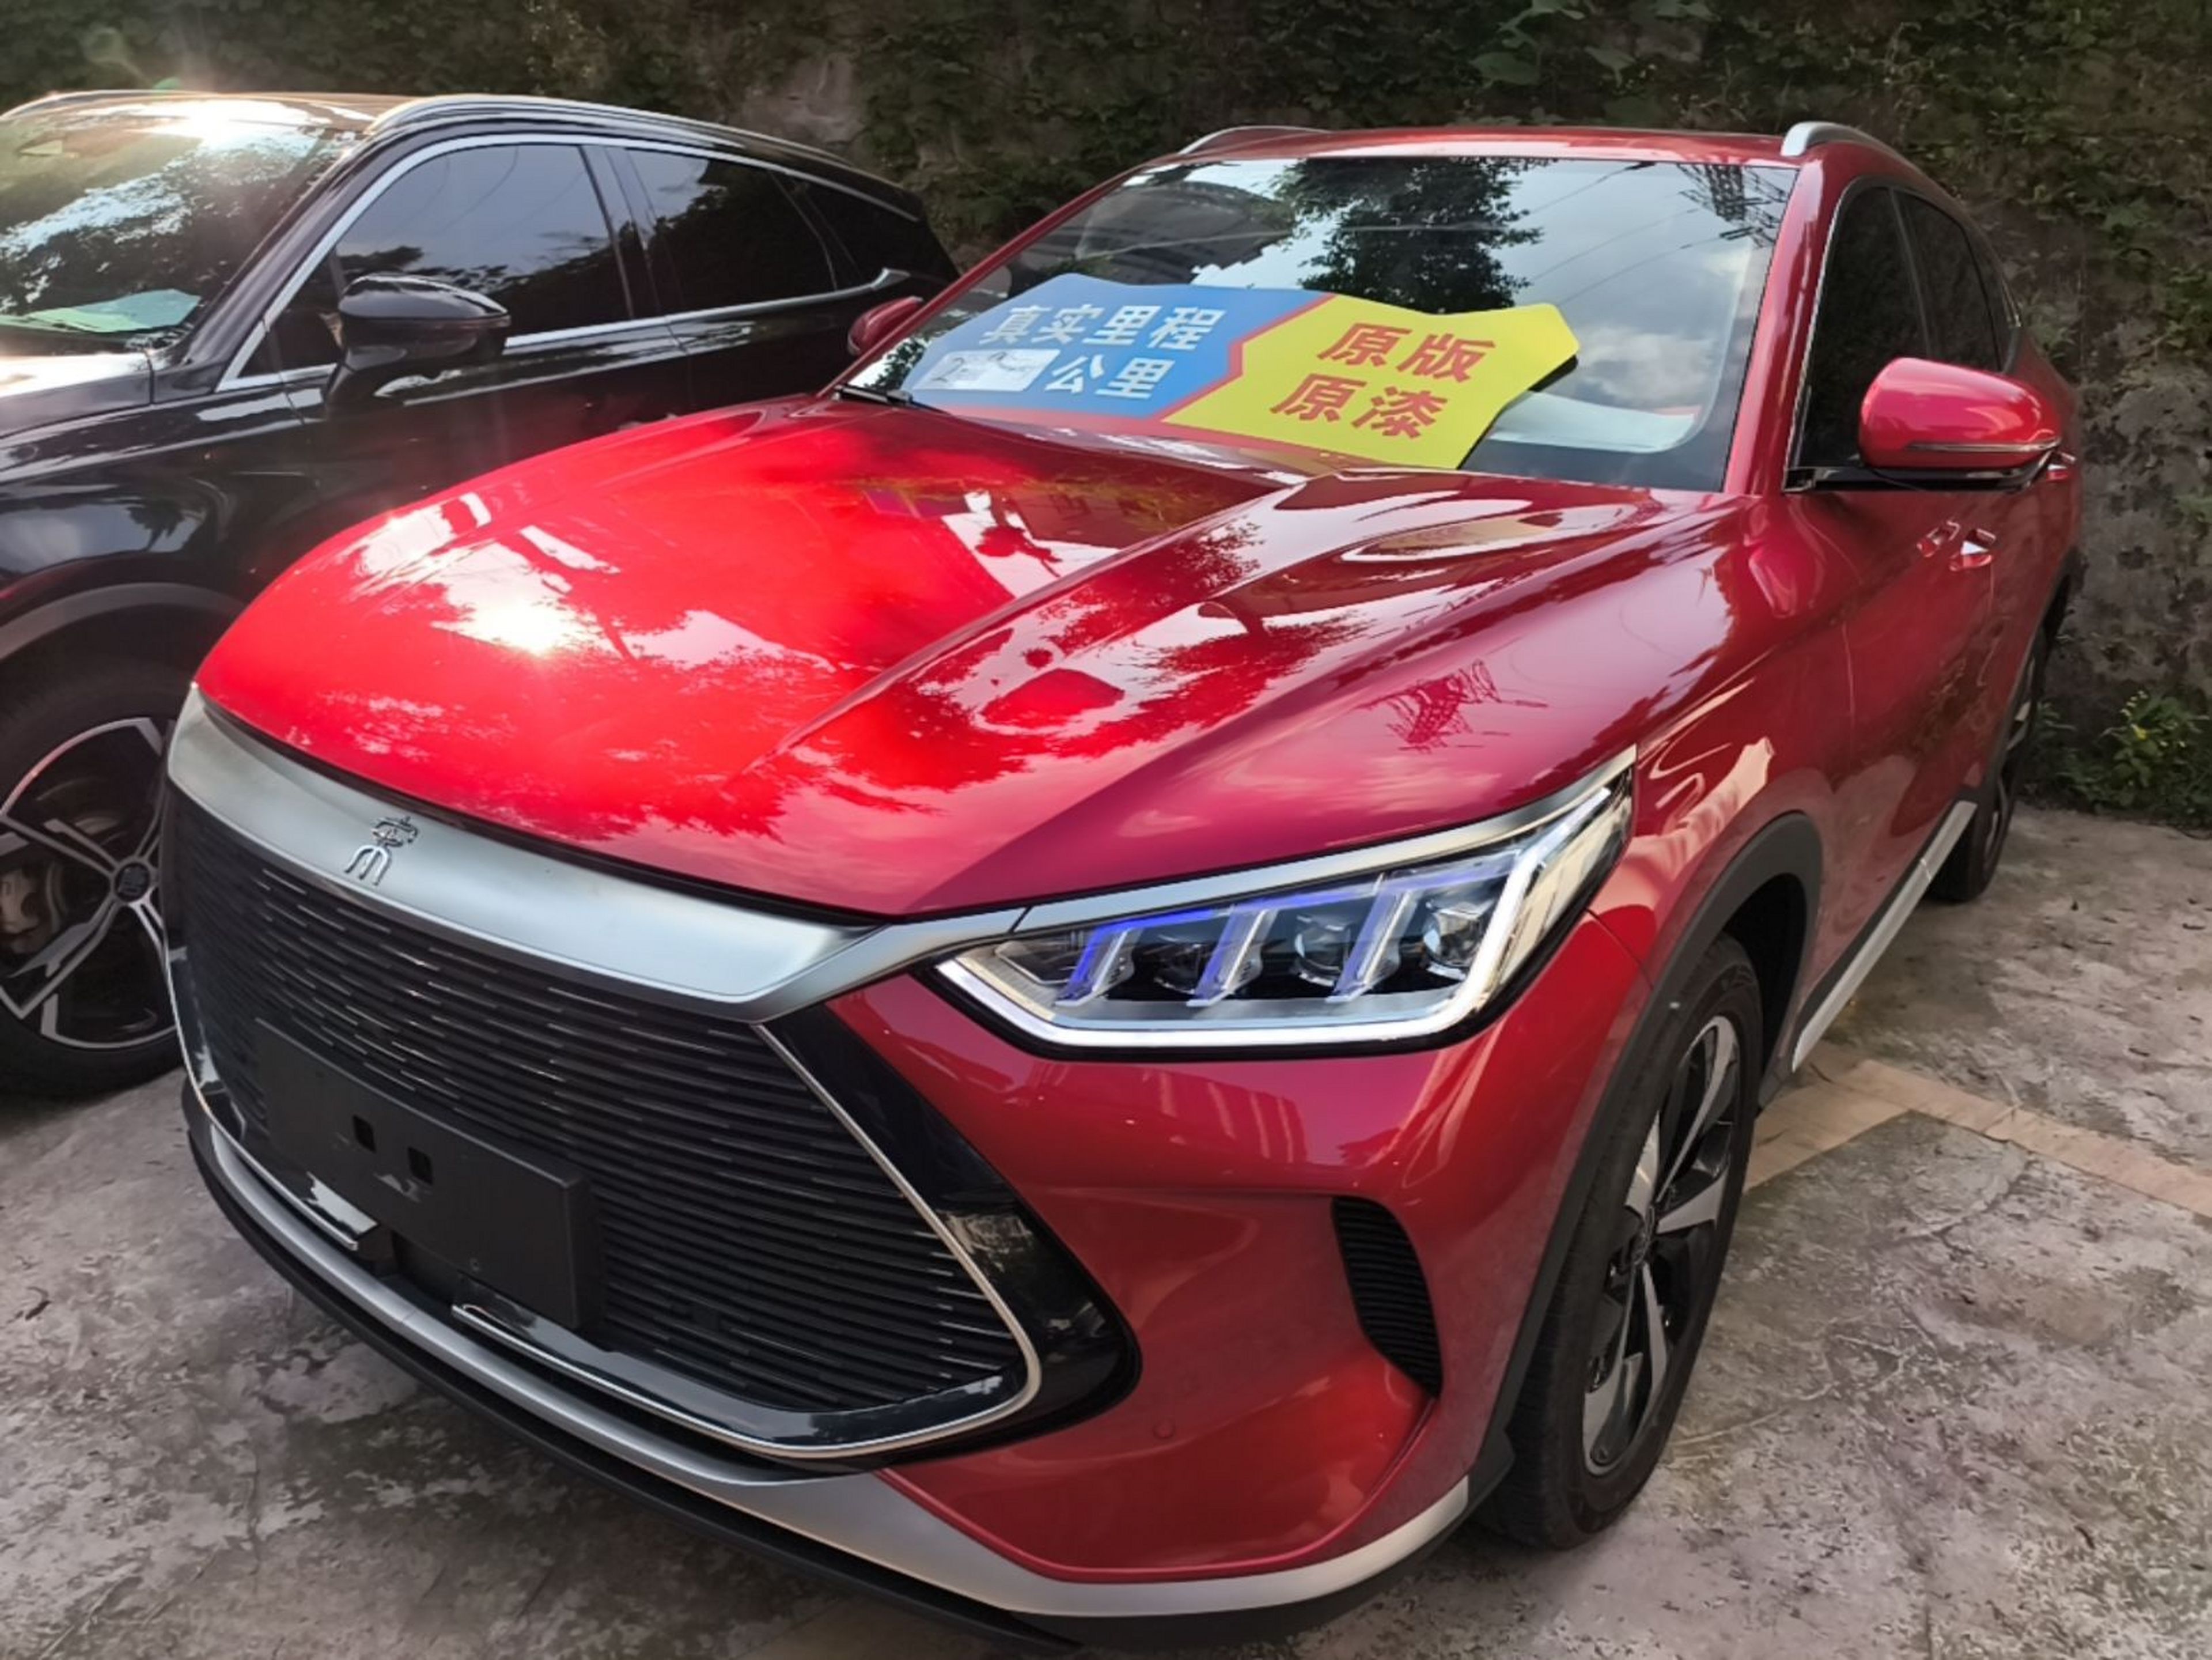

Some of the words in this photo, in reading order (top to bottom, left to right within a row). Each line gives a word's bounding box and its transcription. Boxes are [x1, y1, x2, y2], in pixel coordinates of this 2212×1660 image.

[979, 305, 1226, 351] 真实里程
[1317, 322, 1496, 383] 原版
[1044, 354, 1176, 399] 公里
[1270, 373, 1448, 439] 原漆
